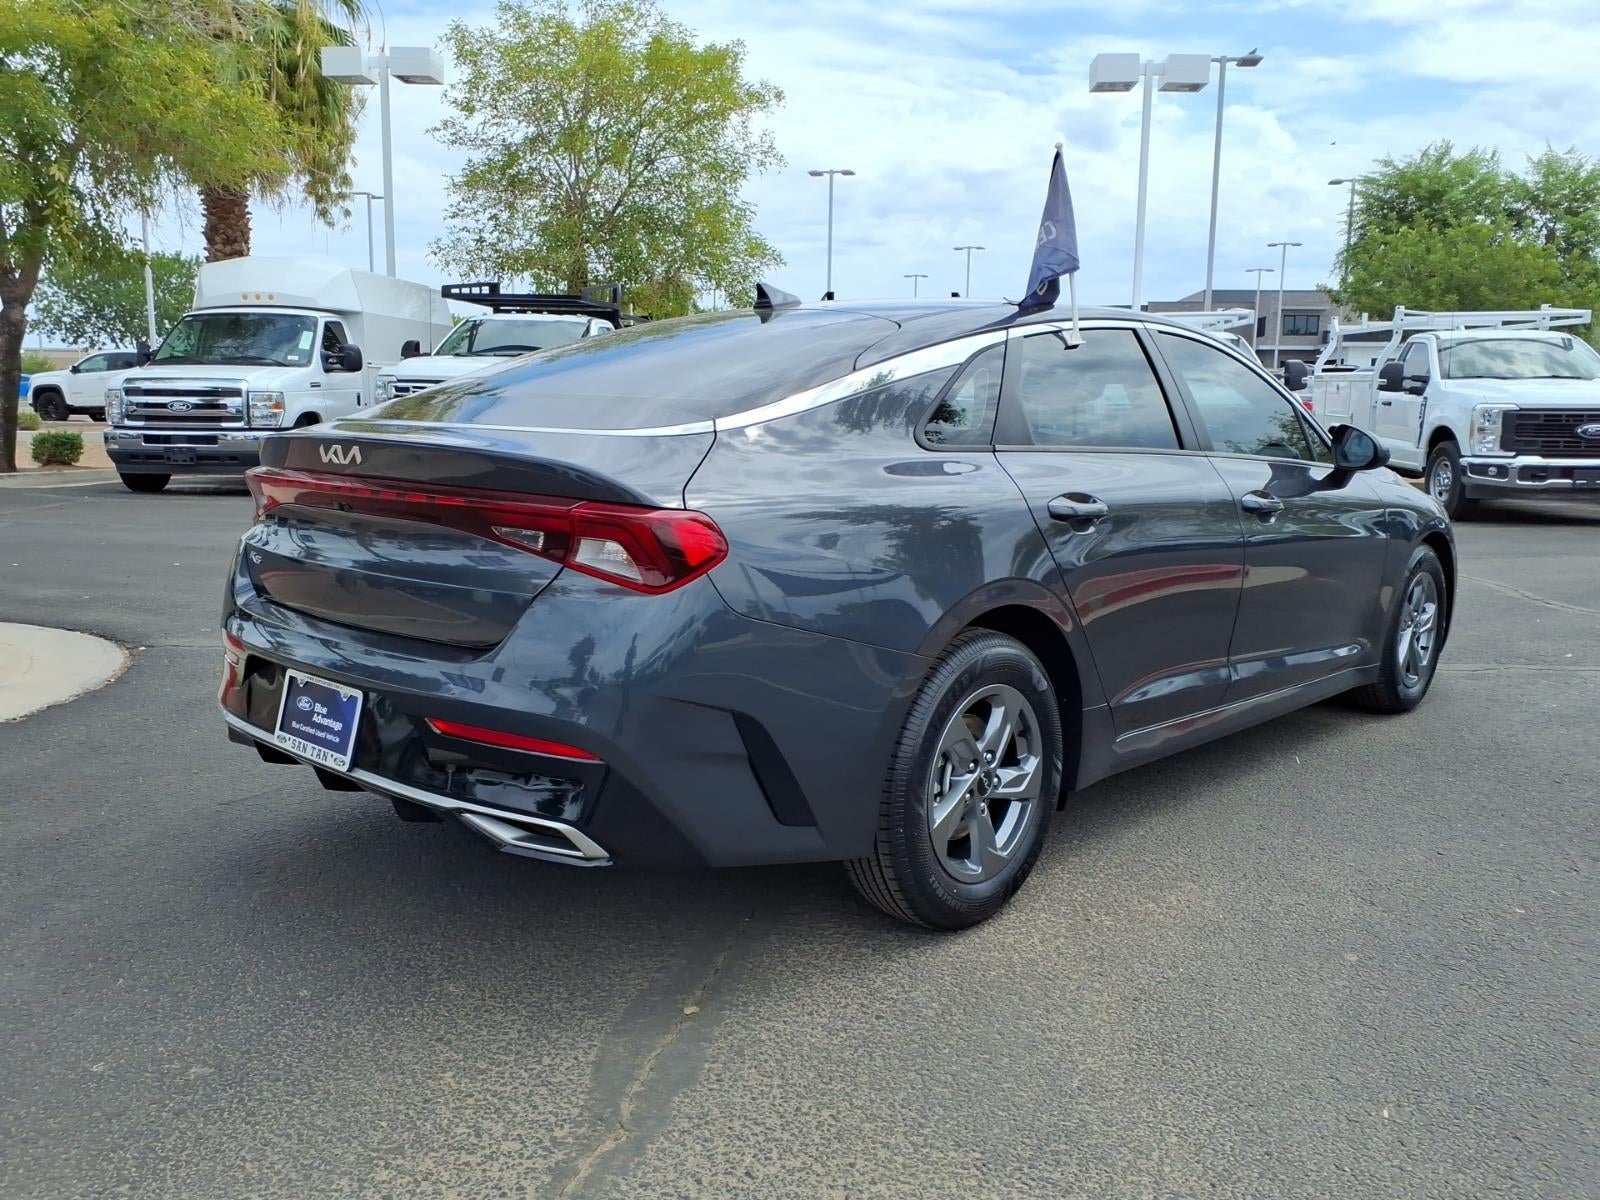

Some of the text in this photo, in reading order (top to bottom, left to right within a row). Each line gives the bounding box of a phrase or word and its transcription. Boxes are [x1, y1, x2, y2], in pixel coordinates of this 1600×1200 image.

[319, 444, 362, 465] KIA
[314, 702, 327, 715] Blue
[300, 723, 315, 735] Certified
[315, 729, 326, 738] Used
[312, 713, 343, 731] Advantage
[291, 739, 308, 754] SAN
[310, 746, 328, 763] TAN
